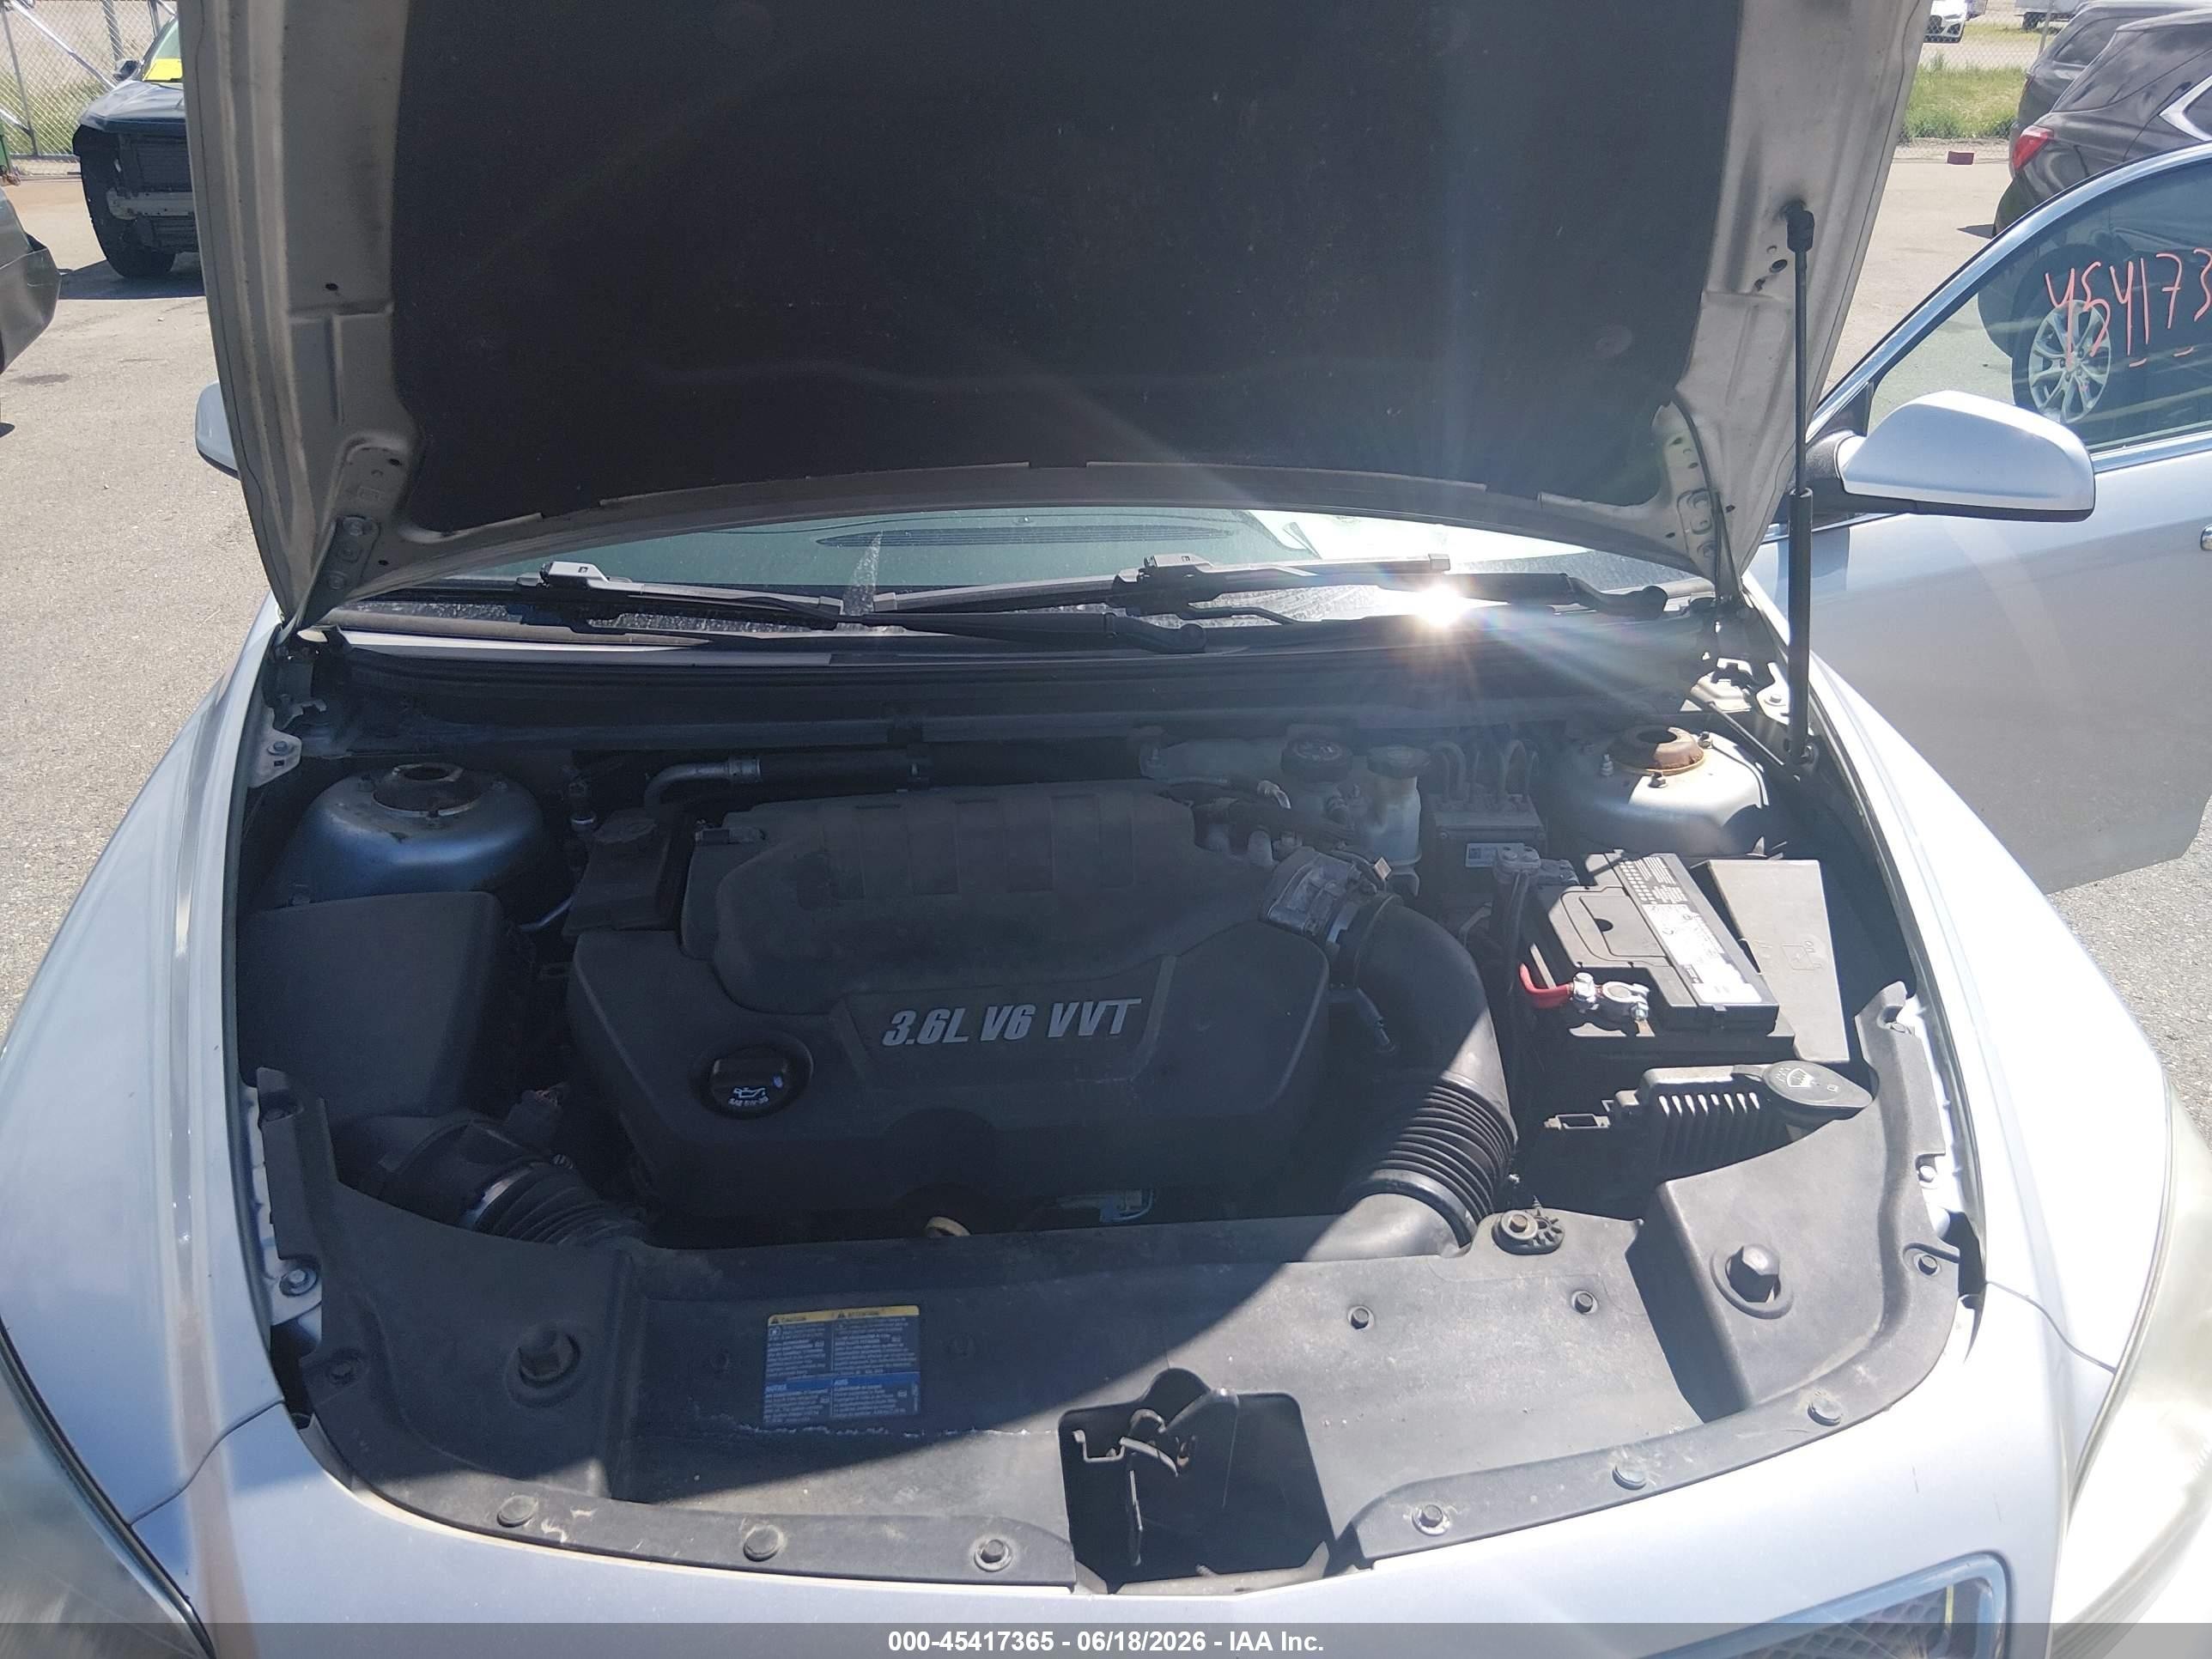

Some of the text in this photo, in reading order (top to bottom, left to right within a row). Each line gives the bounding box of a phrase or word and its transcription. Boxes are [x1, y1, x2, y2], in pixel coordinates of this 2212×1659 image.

[882, 998, 1142, 1046] 3.6L V6 VVT
